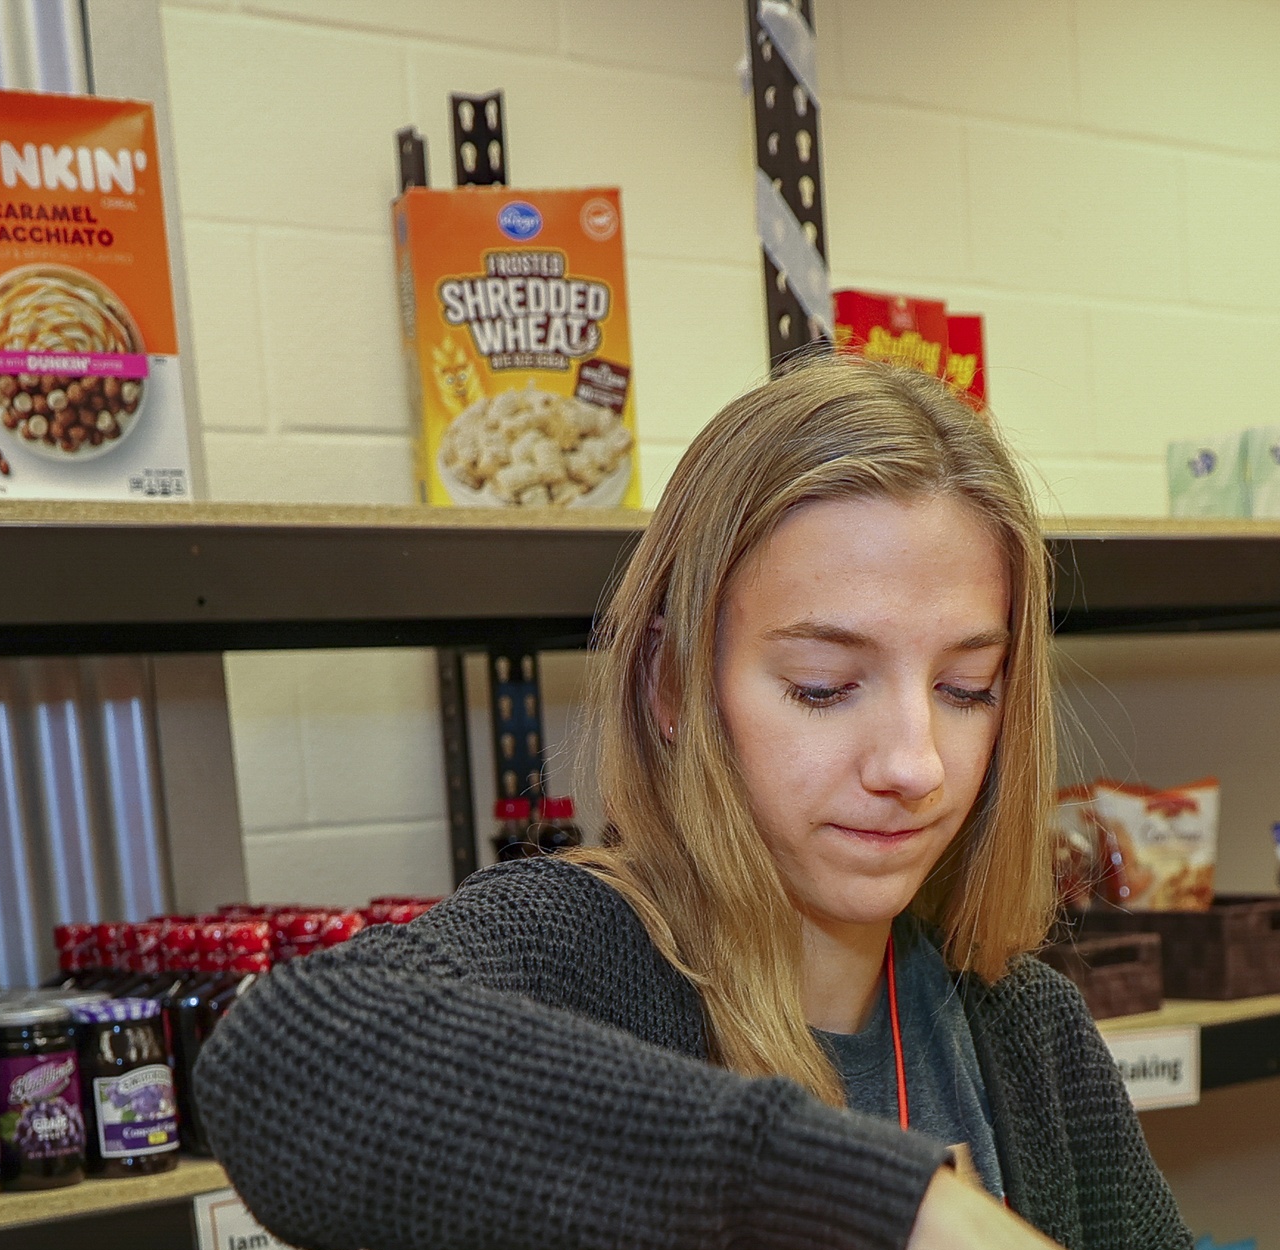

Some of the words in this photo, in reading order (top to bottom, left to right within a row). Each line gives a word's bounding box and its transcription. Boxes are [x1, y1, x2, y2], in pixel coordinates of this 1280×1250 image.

[441, 278, 609, 323] SHREDDED
[471, 316, 599, 356] WHEAT
[27, 356, 91, 371] DUNKIN'
